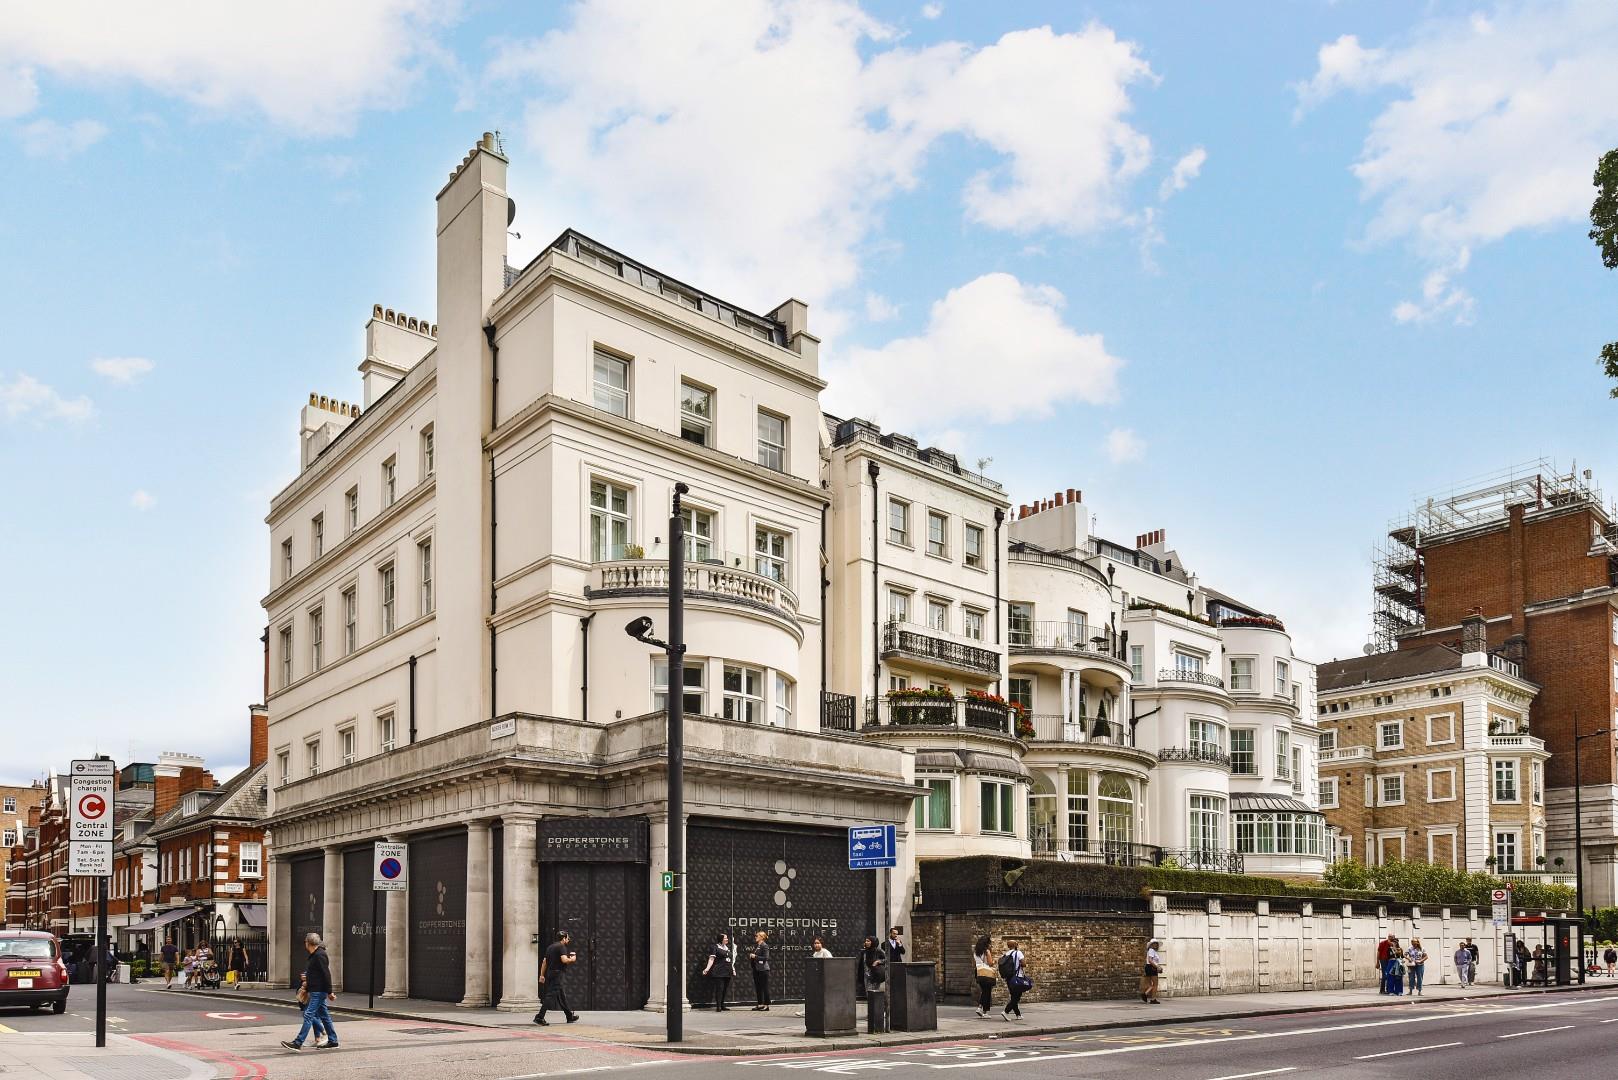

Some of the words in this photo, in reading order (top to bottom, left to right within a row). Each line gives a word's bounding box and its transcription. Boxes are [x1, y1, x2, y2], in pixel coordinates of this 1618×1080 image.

[75, 821, 108, 829] Central
[664, 875, 671, 888] R
[728, 917, 838, 928] COPPERSTONES
